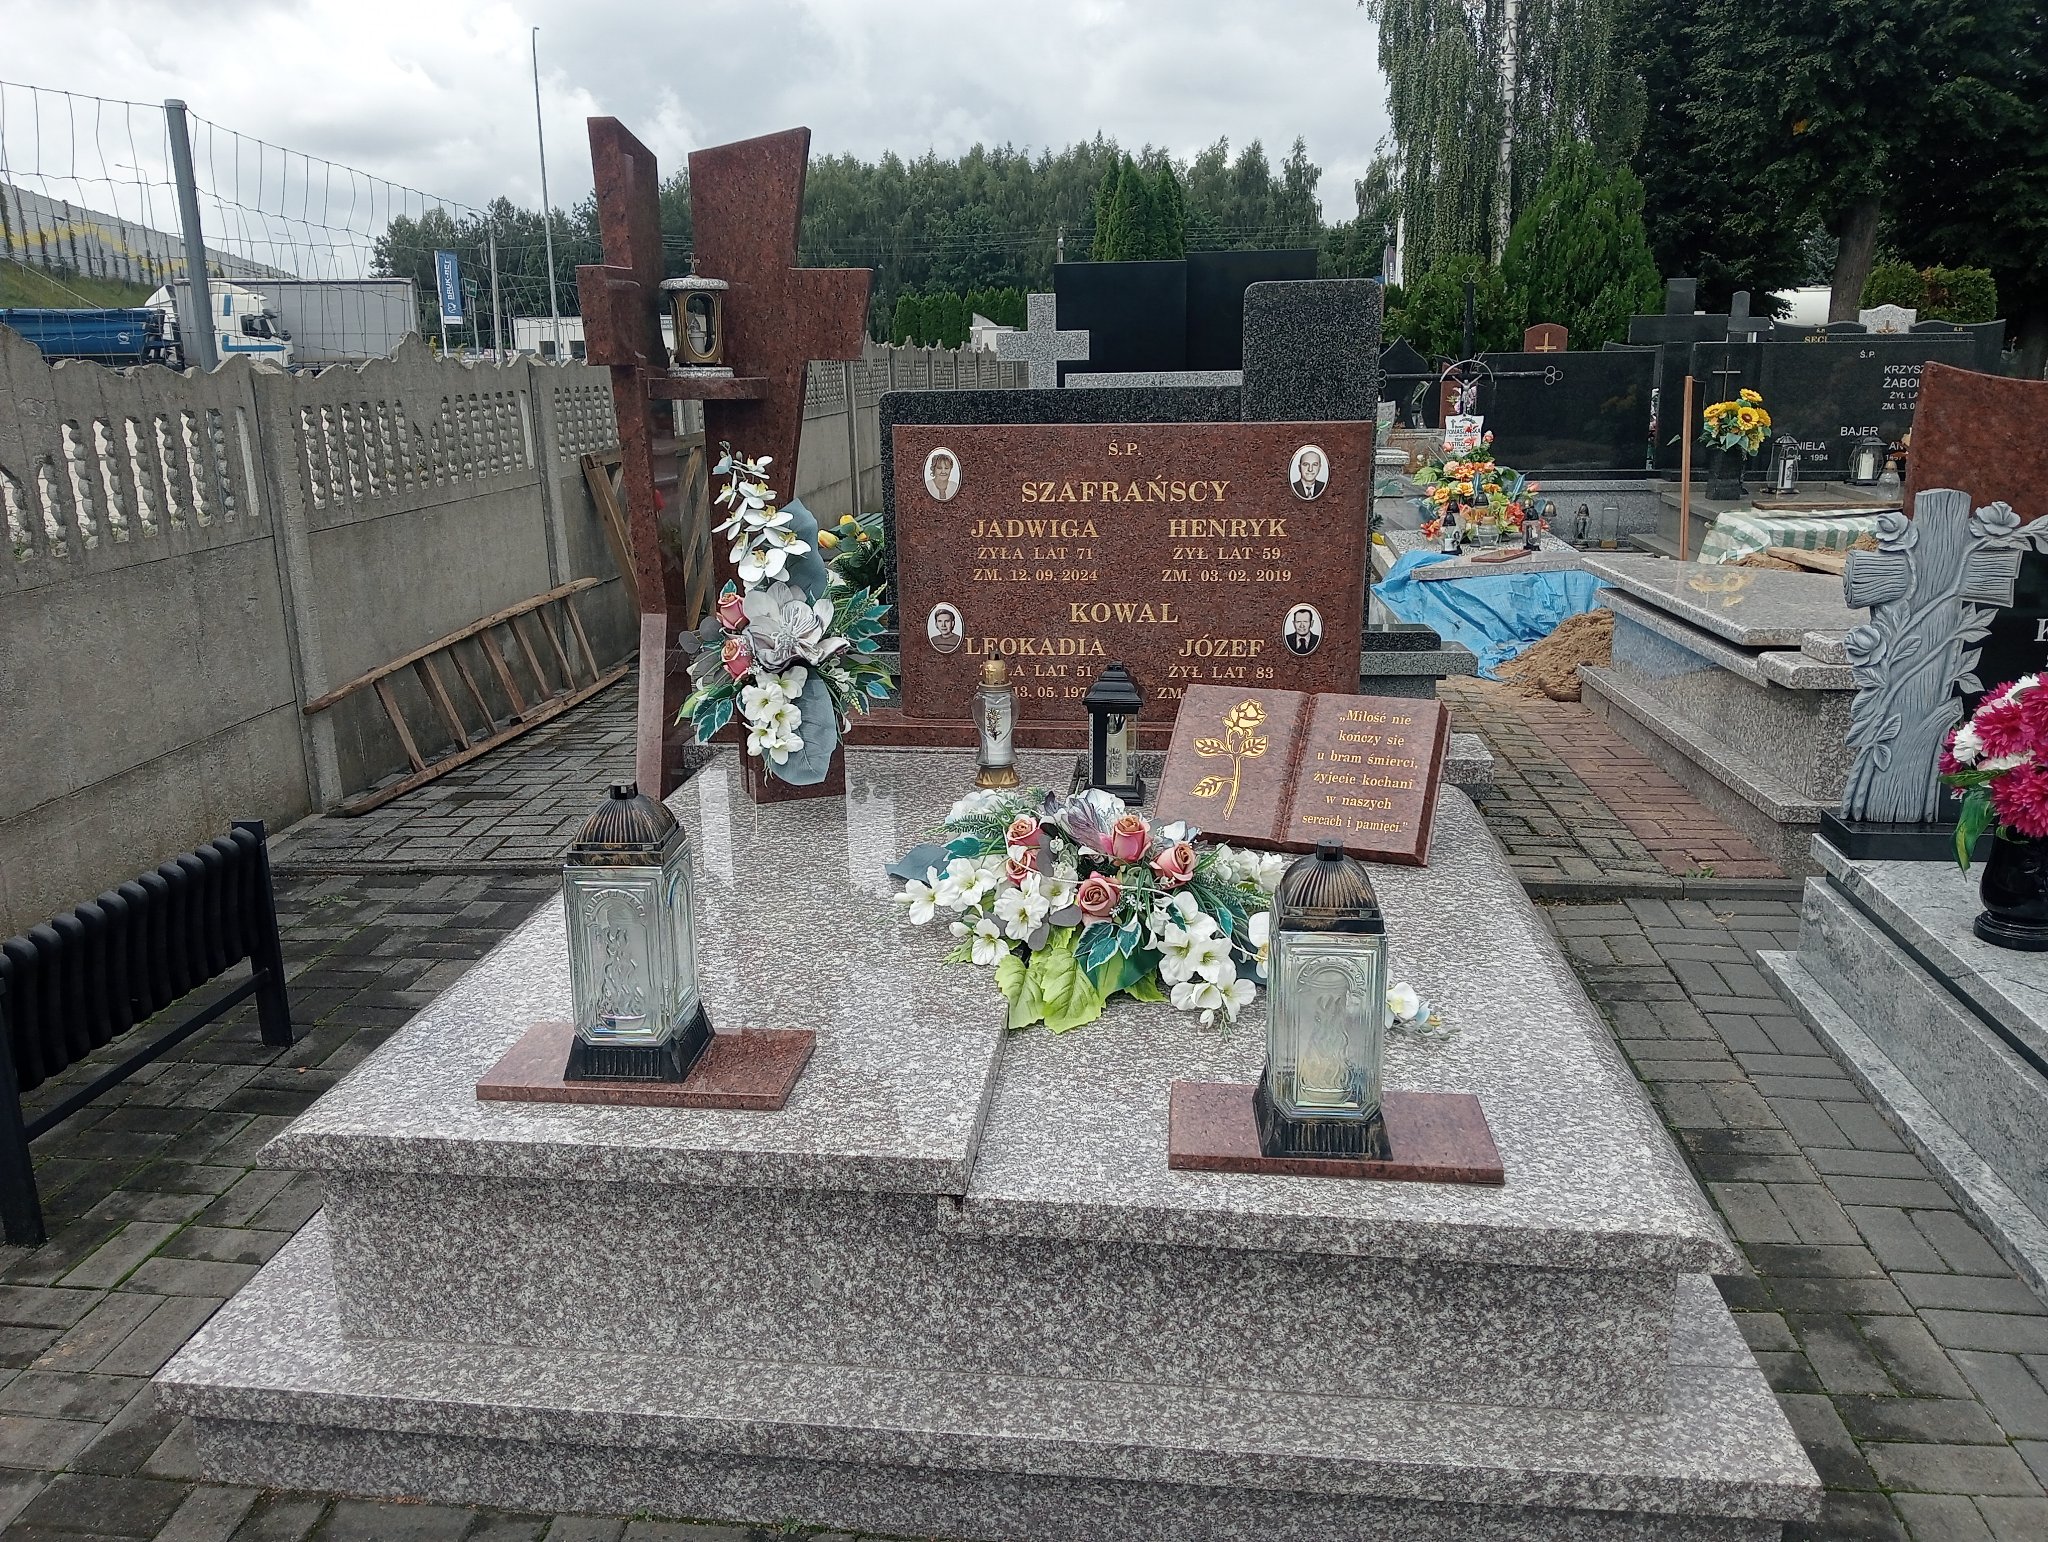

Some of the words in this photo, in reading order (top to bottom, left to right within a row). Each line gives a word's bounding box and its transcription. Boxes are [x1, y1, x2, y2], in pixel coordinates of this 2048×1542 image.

[1884, 365, 1925, 374] KRZYSZ
[1882, 376, 1920, 388] ŻABO
[1908, 391, 1919, 399] LA
[1840, 426, 1879, 436] BAJER
[1021, 474, 1231, 503] SZAFRAŃSCY
[970, 519, 1100, 538] JADWIGA
[1167, 518, 1288, 538] HENRYK
[977, 544, 1025, 560] ŻYŁA
[1033, 547, 1069, 560] LAT
[1076, 547, 1093, 560] 71
[1172, 544, 1209, 560] ŻYŁ
[1217, 546, 1254, 560] LAT
[1262, 547, 1281, 560] 59
[972, 568, 1002, 581] ZM.
[1009, 569, 1032, 581] 12.
[1036, 568, 1058, 581] 09.
[1061, 568, 1098, 581] 2024
[1161, 569, 1192, 582] ZM.
[1200, 569, 1223, 582] 03.
[1228, 569, 1251, 582] 02.
[1255, 569, 1292, 582] 2019
[1069, 602, 1180, 623] KOWAL
[1178, 634, 1265, 658] JÓZEF
[1034, 664, 1068, 677] LAT
[1076, 665, 1093, 677] 51
[1168, 663, 1203, 678] ŻYŁ
[1211, 666, 1247, 679] LAT
[1255, 666, 1274, 679] 83
[1037, 686, 1059, 698] 05.
[1064, 687, 1088, 698] 197
[1391, 715, 1412, 725] nie
[1338, 730, 1382, 746] kończy
[1386, 735, 1405, 748] się
[1317, 752, 1325, 760] u
[1330, 750, 1362, 763] bram
[1313, 771, 1356, 785] żyjecie
[1361, 774, 1414, 790] kochani
[1325, 795, 1337, 804] w
[1341, 797, 1392, 811] naszych
[1302, 814, 1342, 827] sercach
[1346, 816, 1352, 828] i
